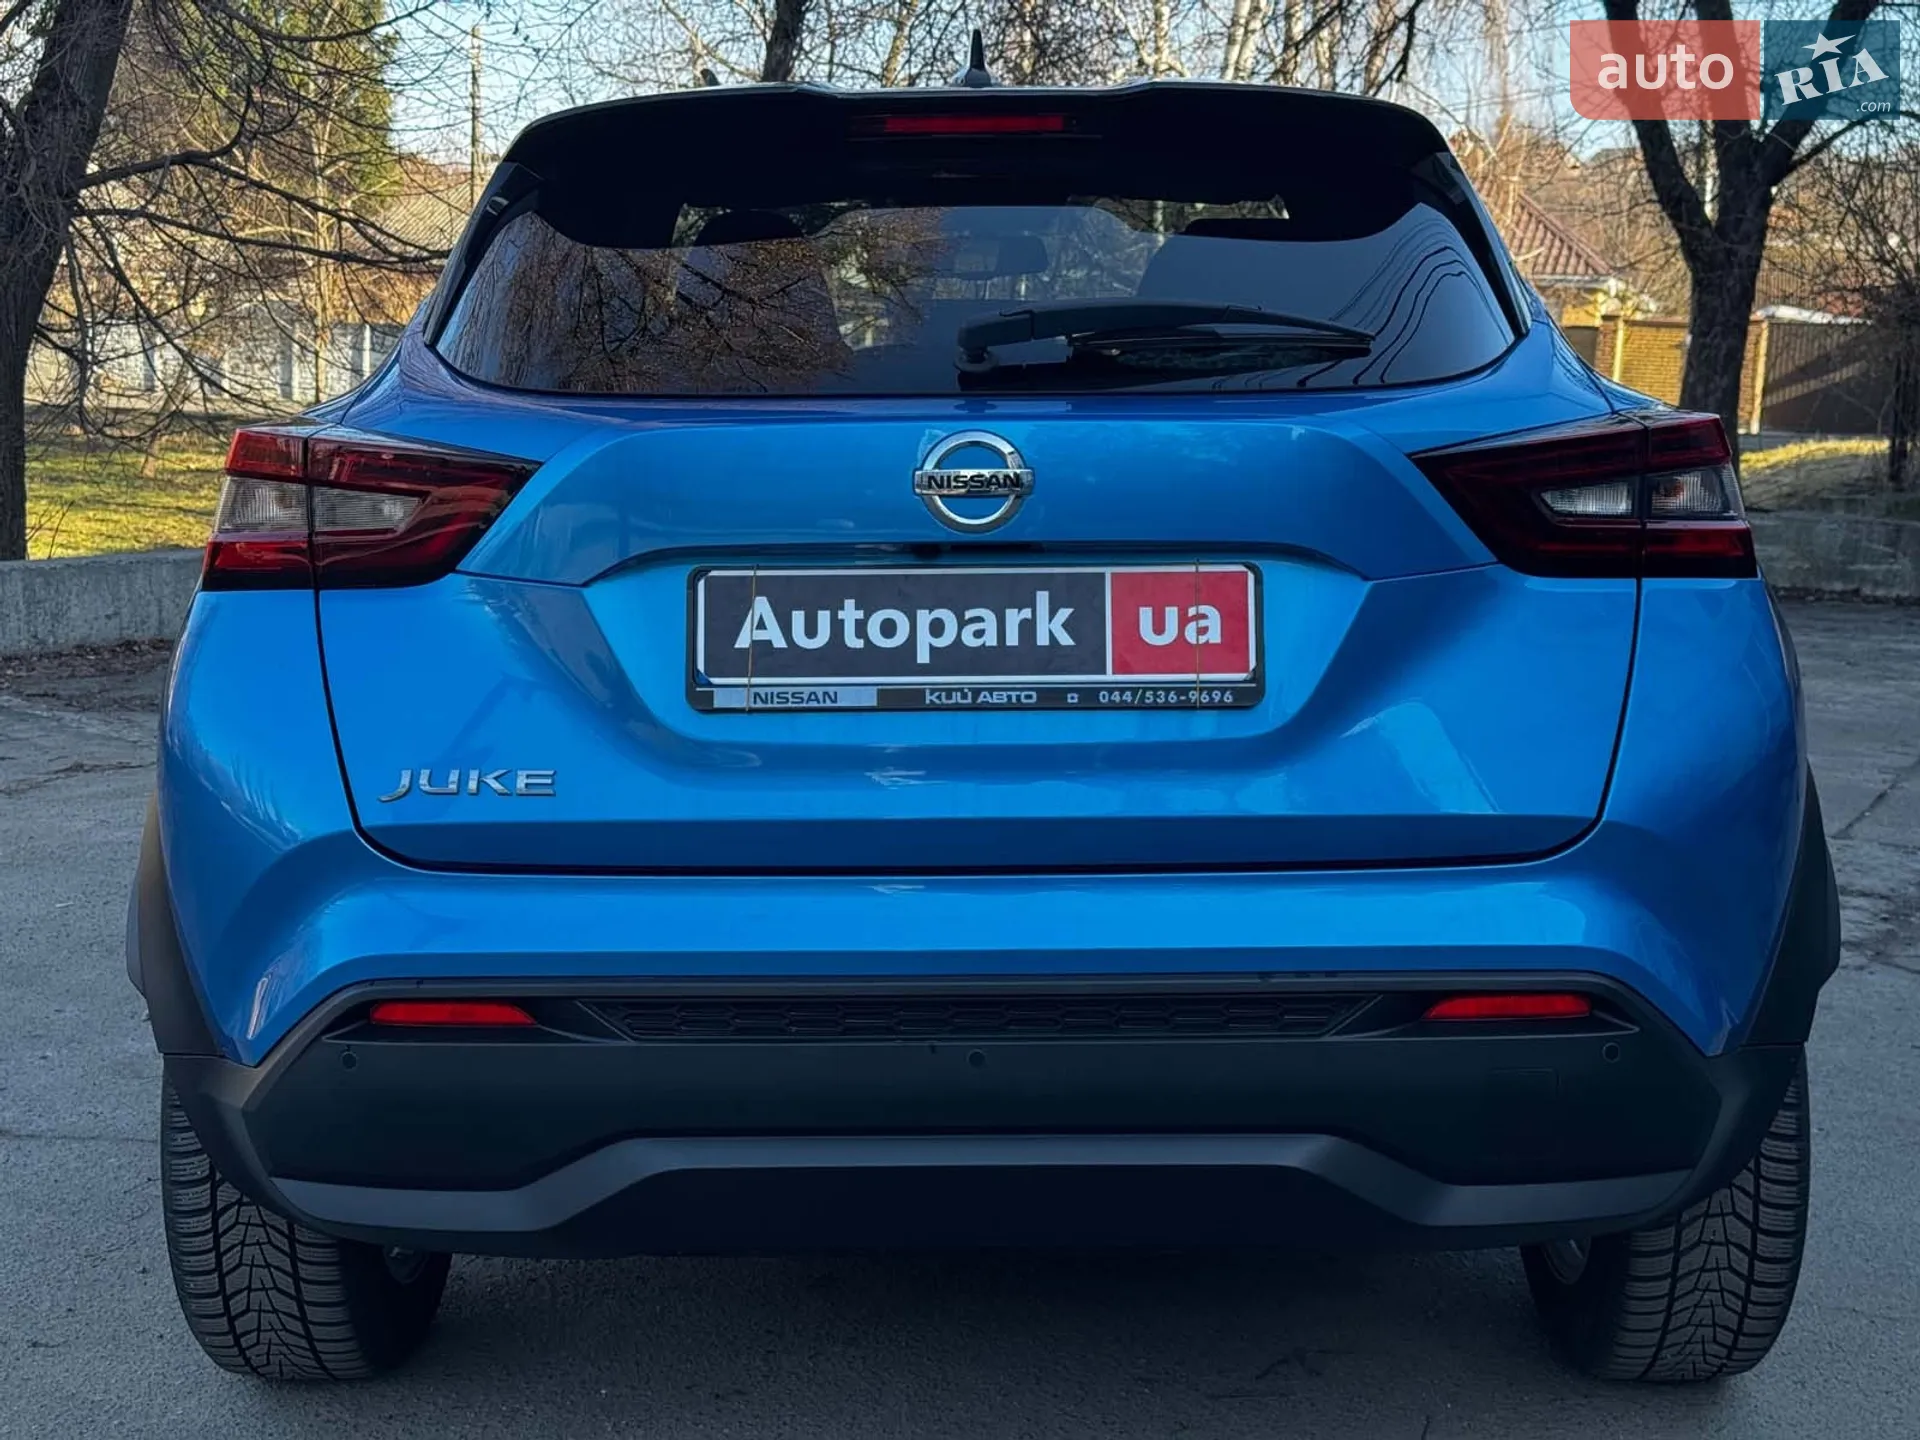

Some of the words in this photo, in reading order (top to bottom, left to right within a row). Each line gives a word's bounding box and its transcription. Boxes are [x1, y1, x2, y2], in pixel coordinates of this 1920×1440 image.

[927, 474, 1021, 490] NISSAN
[734, 591, 1076, 663] Autopark
[1138, 603, 1223, 645] ua
[752, 690, 838, 705] NISSAN
[1099, 688, 1234, 705] 044/536-9696
[378, 768, 556, 803] JUKE
